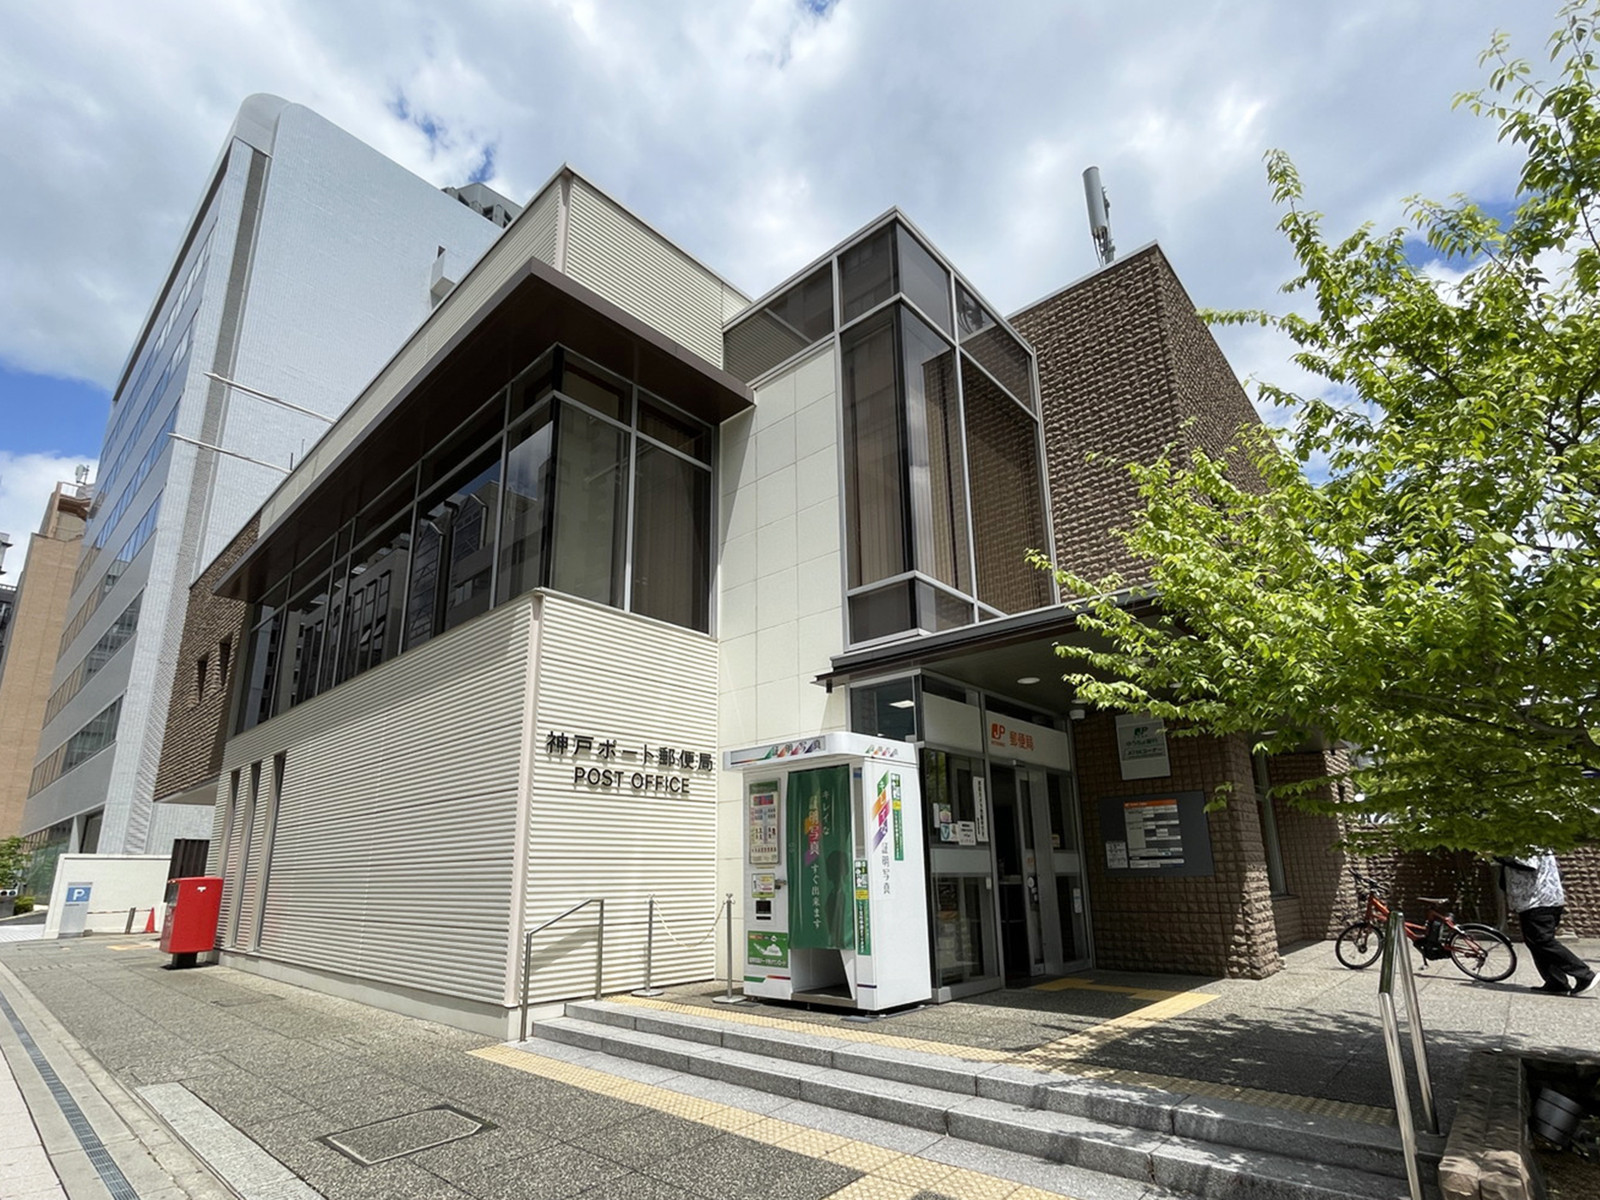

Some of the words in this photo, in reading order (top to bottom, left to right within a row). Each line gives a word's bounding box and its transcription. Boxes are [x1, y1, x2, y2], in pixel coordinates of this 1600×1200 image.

[547, 731, 713, 772] 神戸ポート郵便局
[574, 767, 624, 787] POST
[631, 773, 690, 793] OFFICE
[73, 889, 85, 901] P
